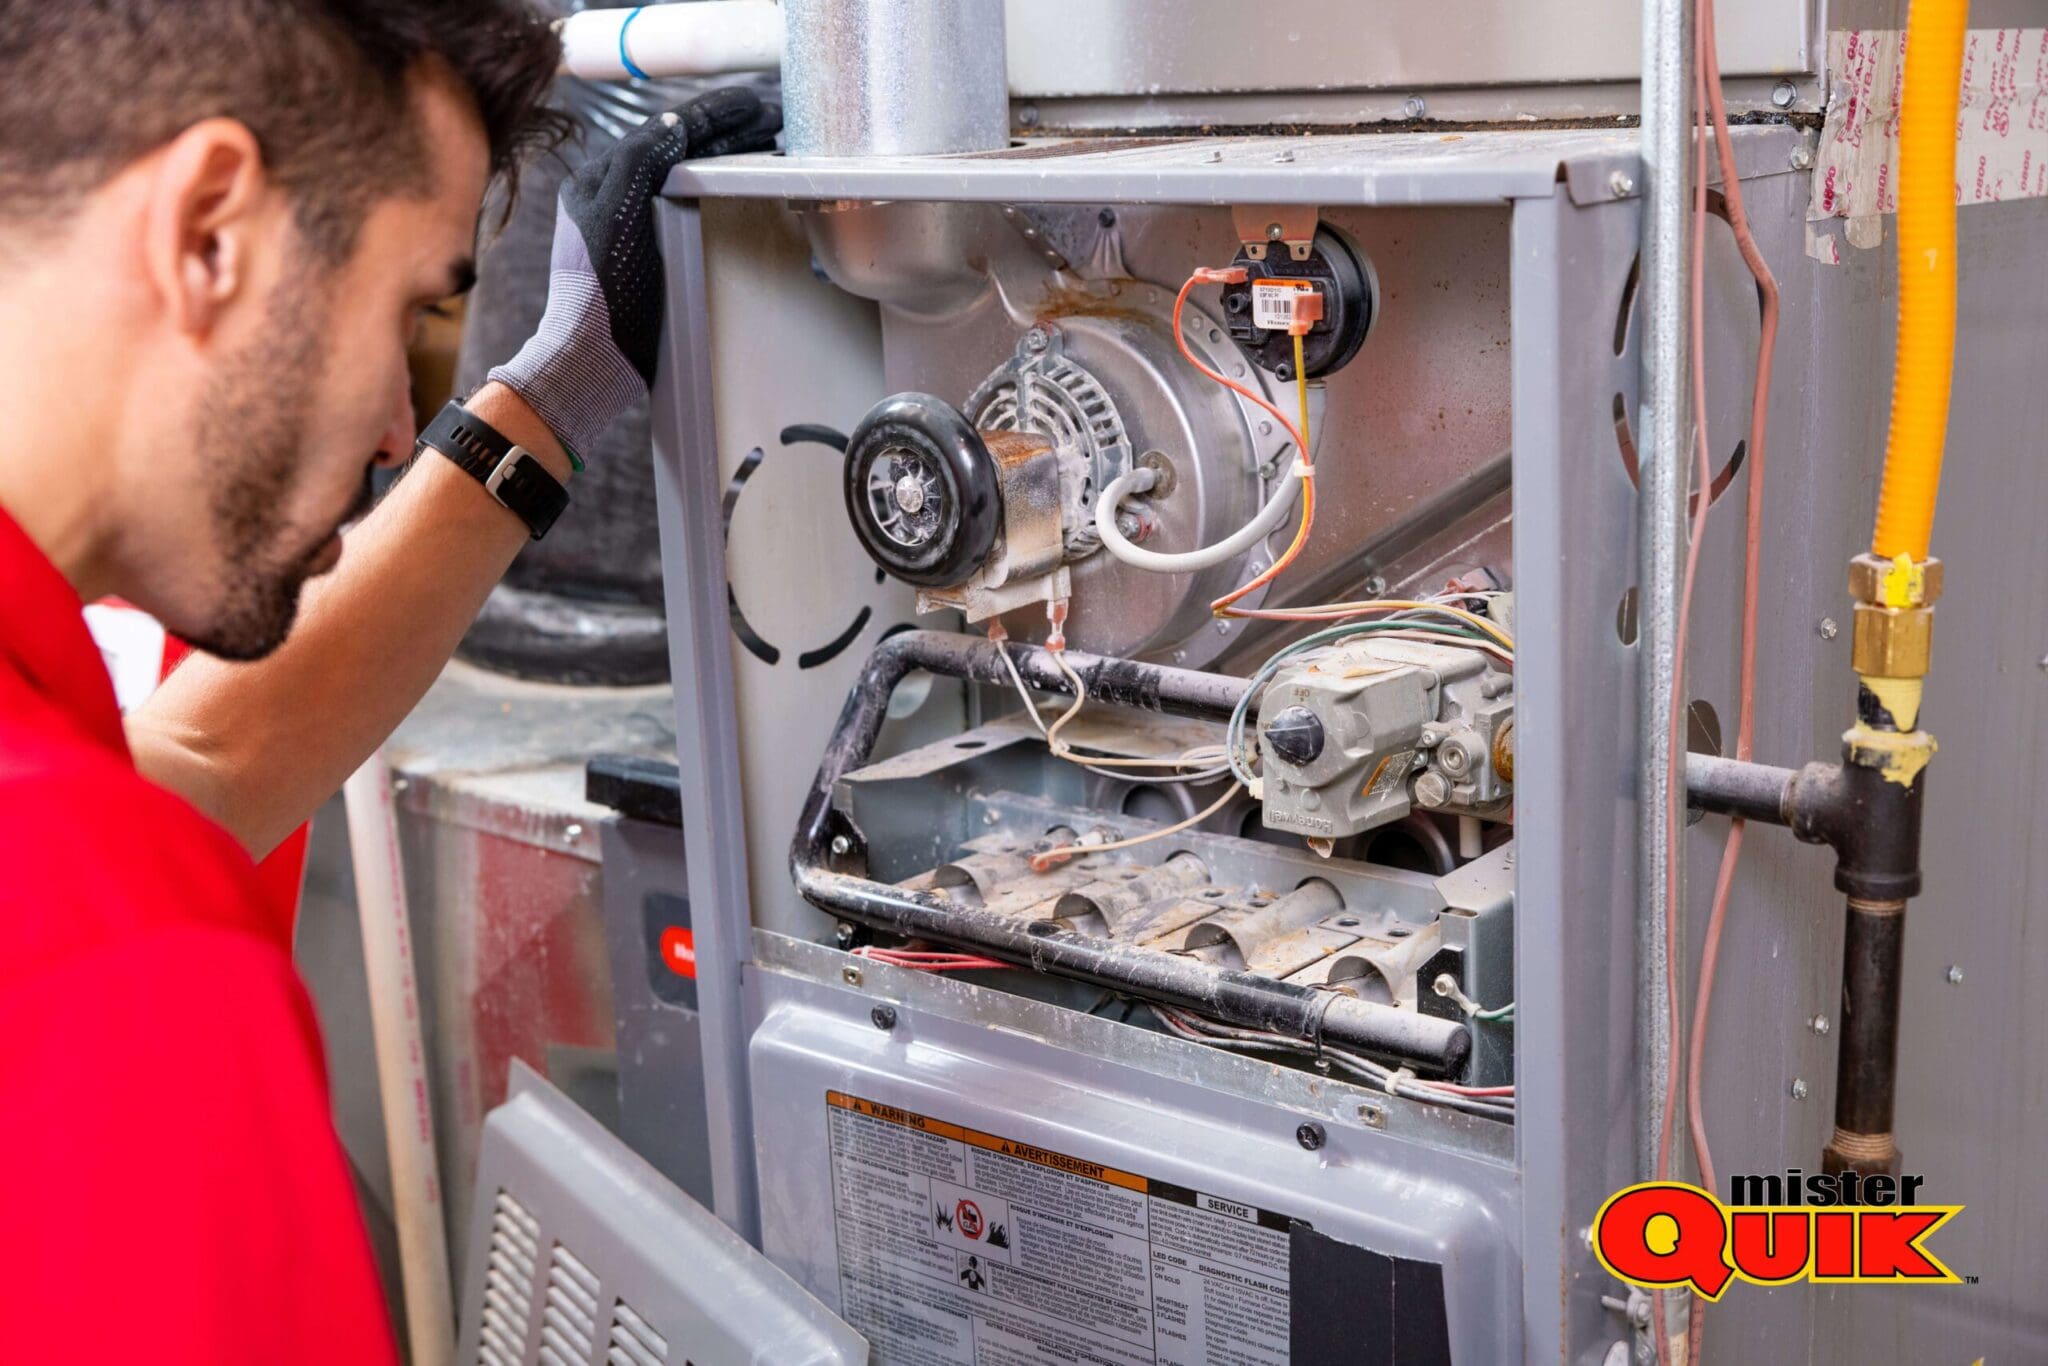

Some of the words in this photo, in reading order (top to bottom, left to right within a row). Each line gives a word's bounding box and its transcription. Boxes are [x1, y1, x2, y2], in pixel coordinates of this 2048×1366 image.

[1975, 156, 1986, 199] 0800
[2021, 150, 2031, 190] 0800
[1877, 164, 1888, 209] 0800
[1013, 1144, 1104, 1179] AVERTISSEMENT
[1208, 1199, 1248, 1218] SERVICE
[1152, 1250, 1166, 1260] LED
[1168, 1255, 1186, 1266] CODE
[1154, 1264, 1164, 1272] OFF
[1154, 1272, 1162, 1280] ON
[1164, 1274, 1180, 1285] SOLID
[1199, 1264, 1242, 1283] DIAGNOSTIC
[1244, 1277, 1267, 1291] FLASH
